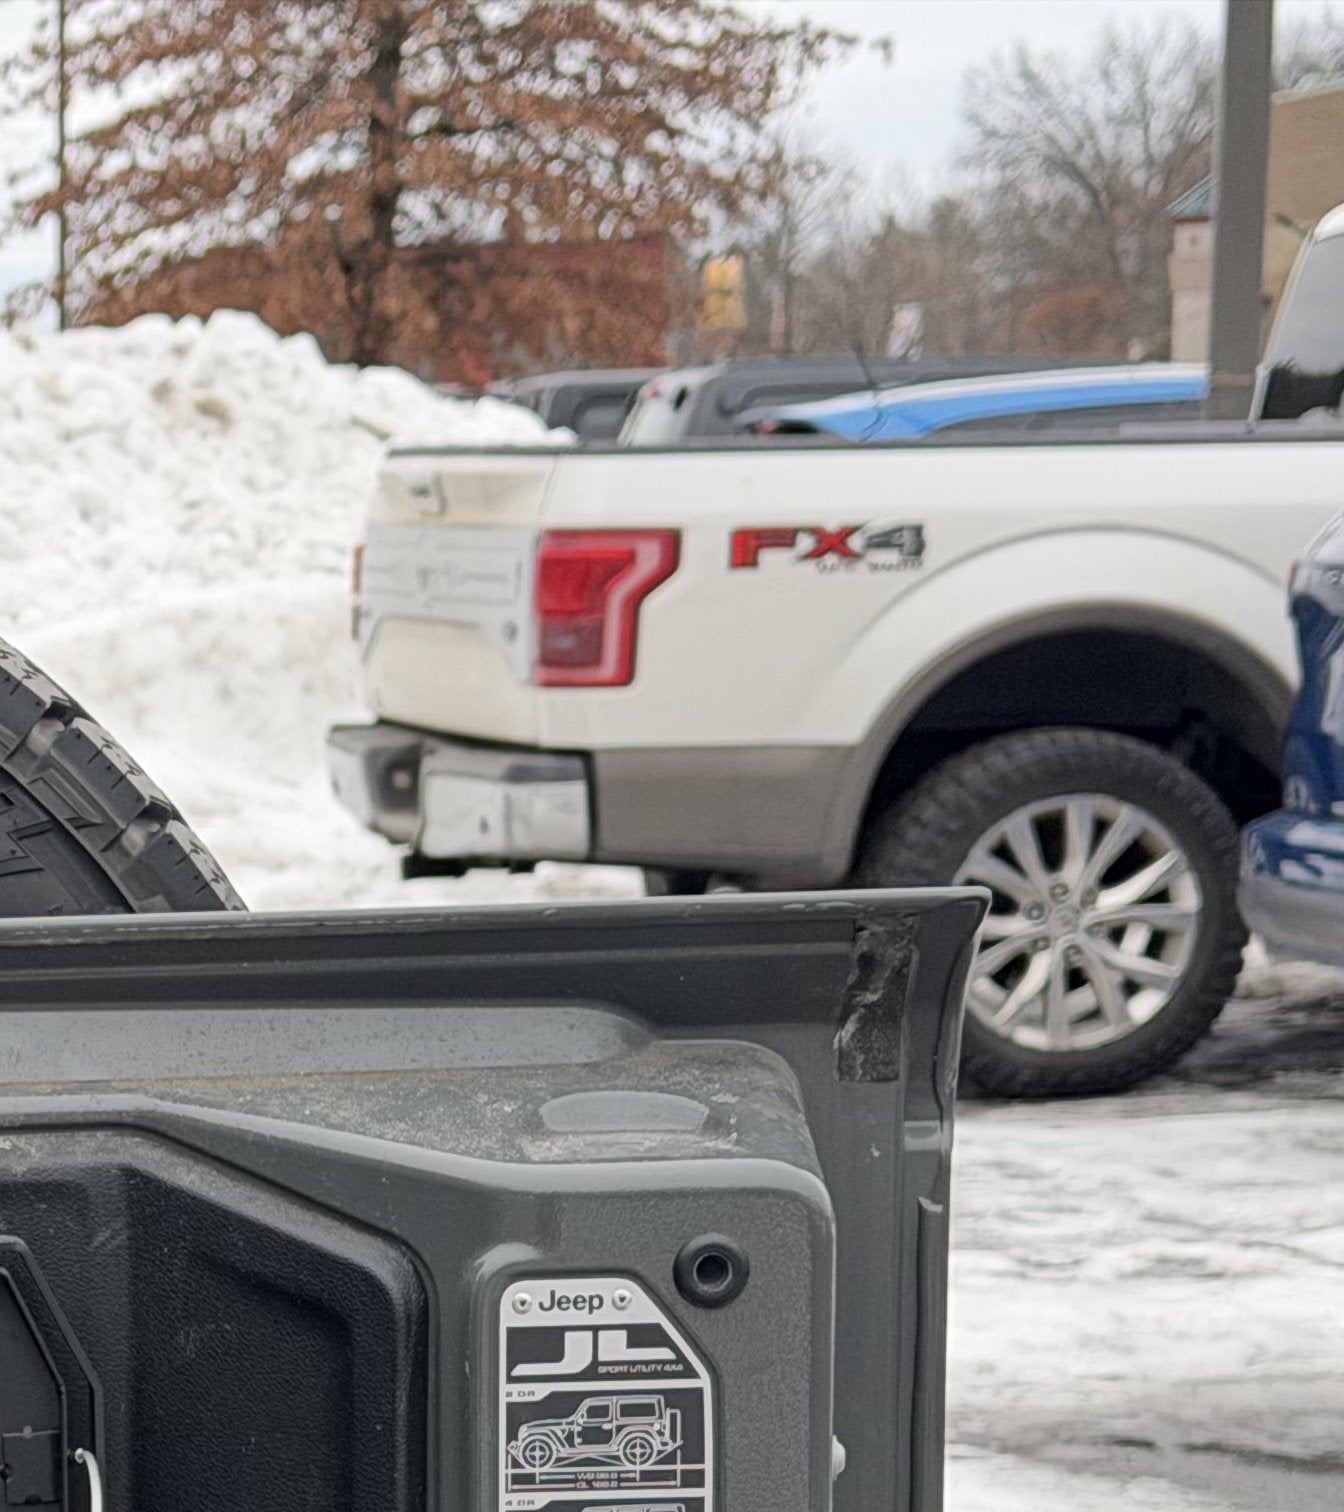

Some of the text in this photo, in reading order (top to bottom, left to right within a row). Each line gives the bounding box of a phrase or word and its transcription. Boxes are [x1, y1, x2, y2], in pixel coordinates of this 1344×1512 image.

[729, 524, 925, 569] FX4
[538, 1290, 604, 1315] Jeep
[510, 1329, 677, 1377] JL
[598, 1365, 629, 1374] SPORT
[629, 1364, 662, 1373] UTILITY
